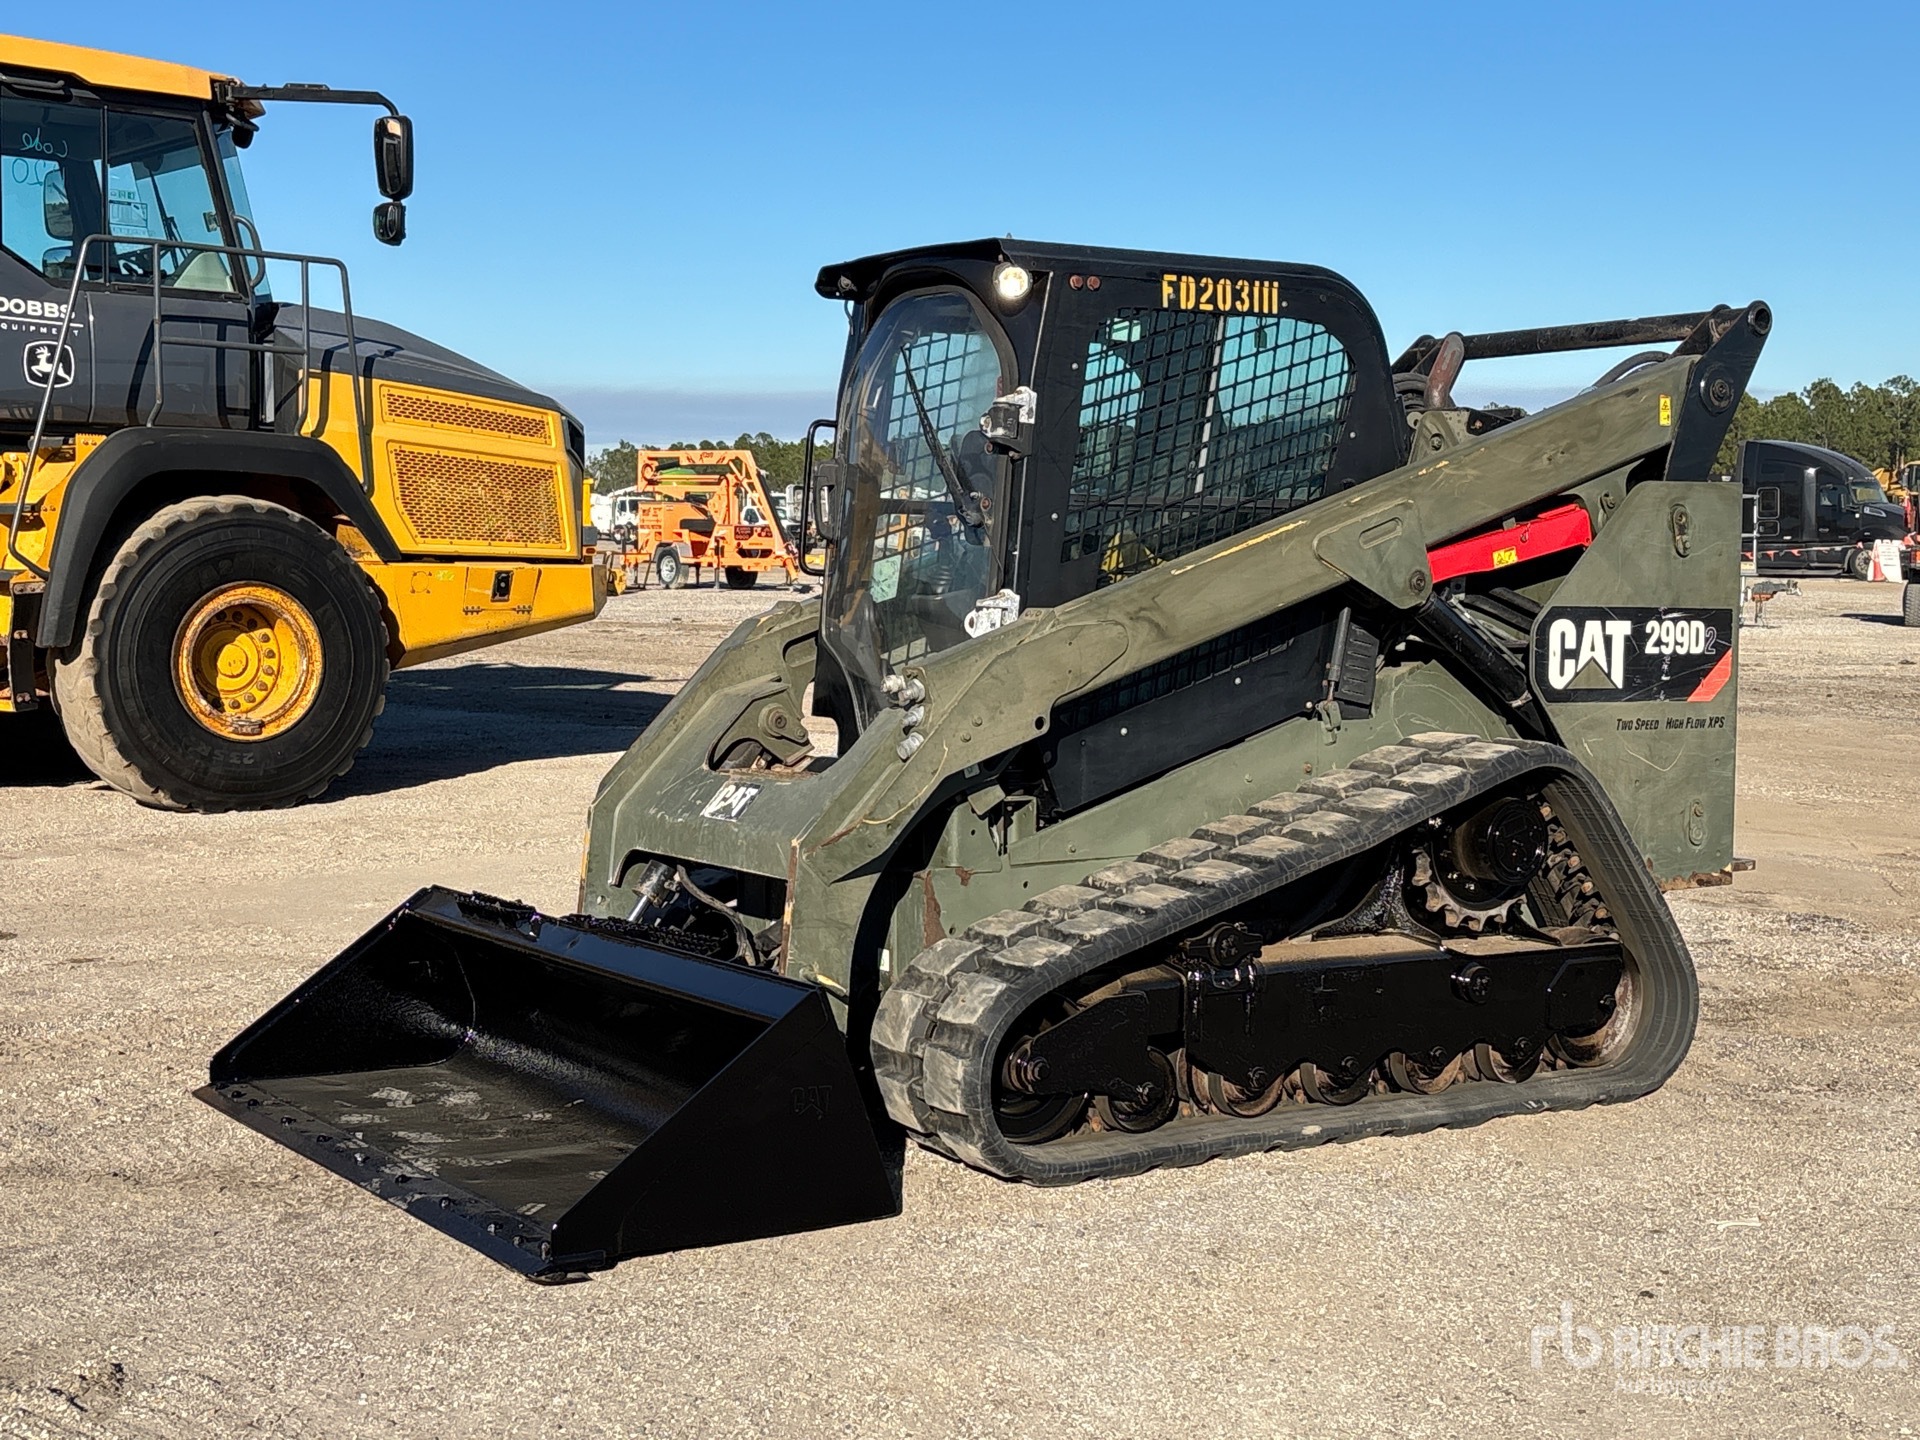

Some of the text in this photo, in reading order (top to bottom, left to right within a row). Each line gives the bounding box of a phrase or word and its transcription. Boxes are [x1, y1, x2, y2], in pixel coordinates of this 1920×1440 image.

[1548, 618, 1632, 690] CAT
[1645, 620, 1718, 655] 299D2
[1707, 715, 1726, 729] XPS
[703, 784, 759, 818] CAT
